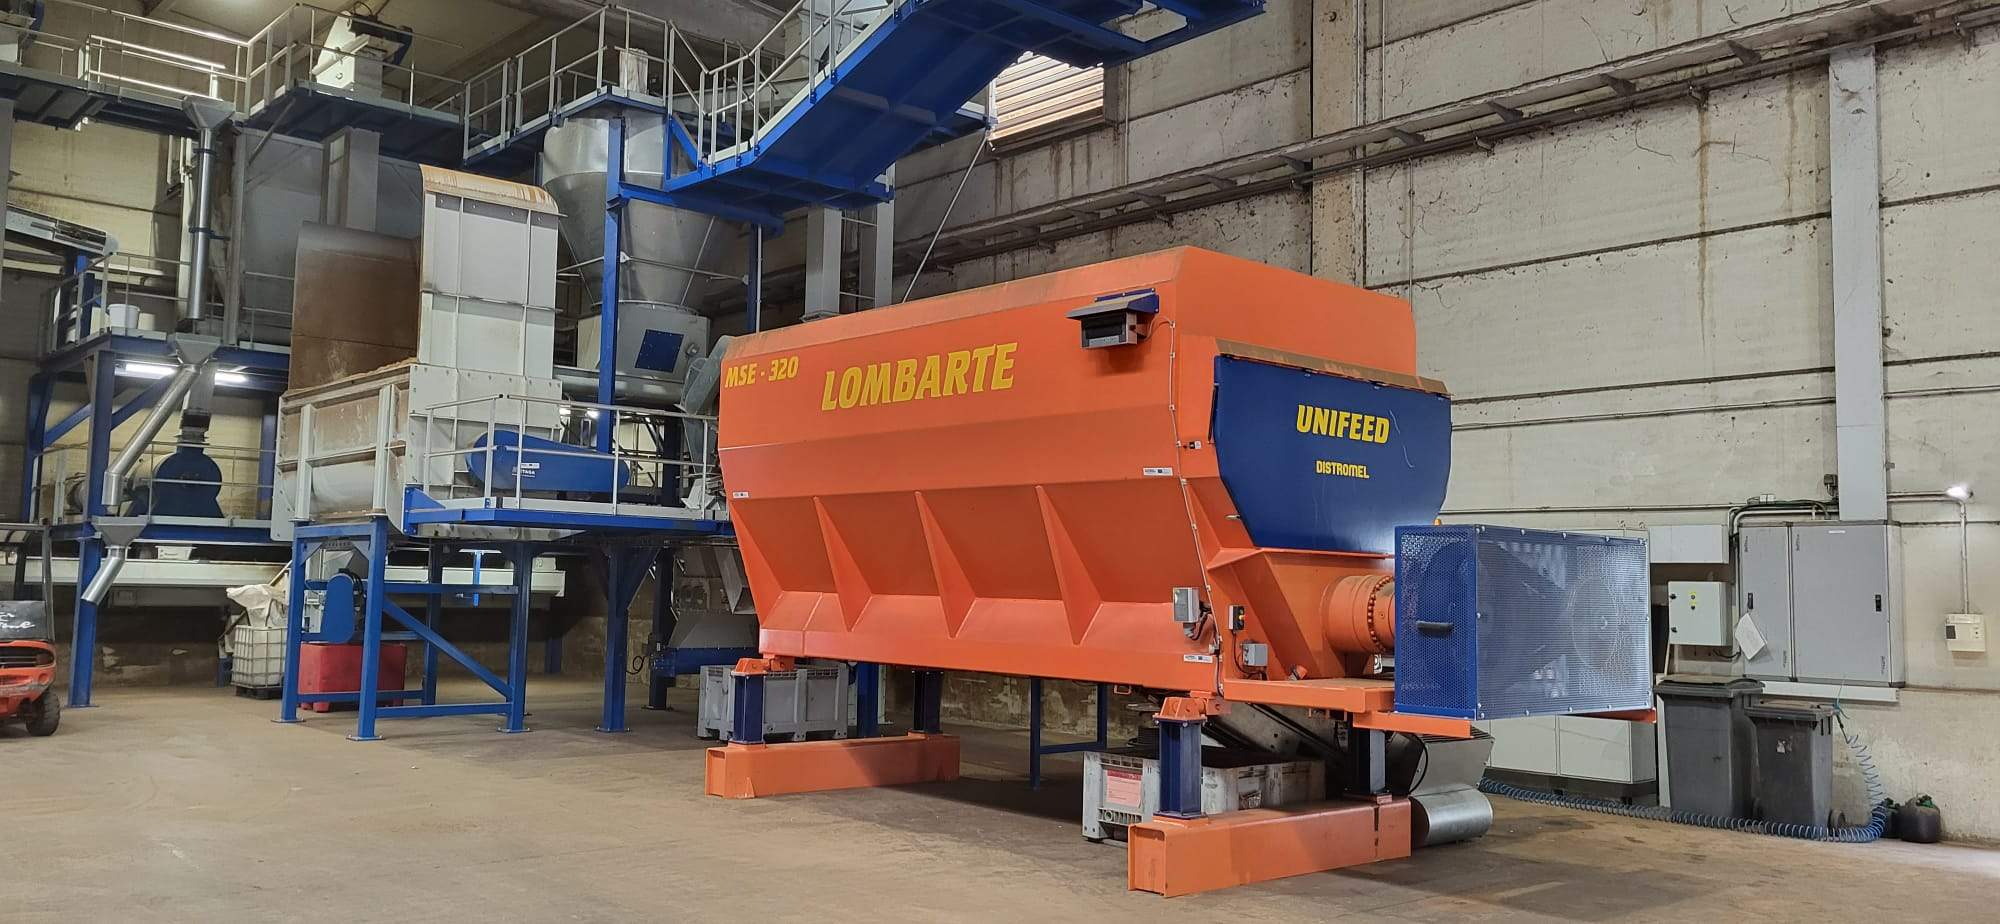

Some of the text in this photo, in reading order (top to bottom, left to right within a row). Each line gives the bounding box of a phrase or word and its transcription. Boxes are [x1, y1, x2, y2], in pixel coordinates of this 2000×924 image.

[724, 363, 758, 388] MSE
[768, 356, 799, 382] 320
[821, 342, 1018, 411] LOMBARTE
[1296, 404, 1390, 444] UNIFEED
[1316, 460, 1370, 479] DISTROMEL
